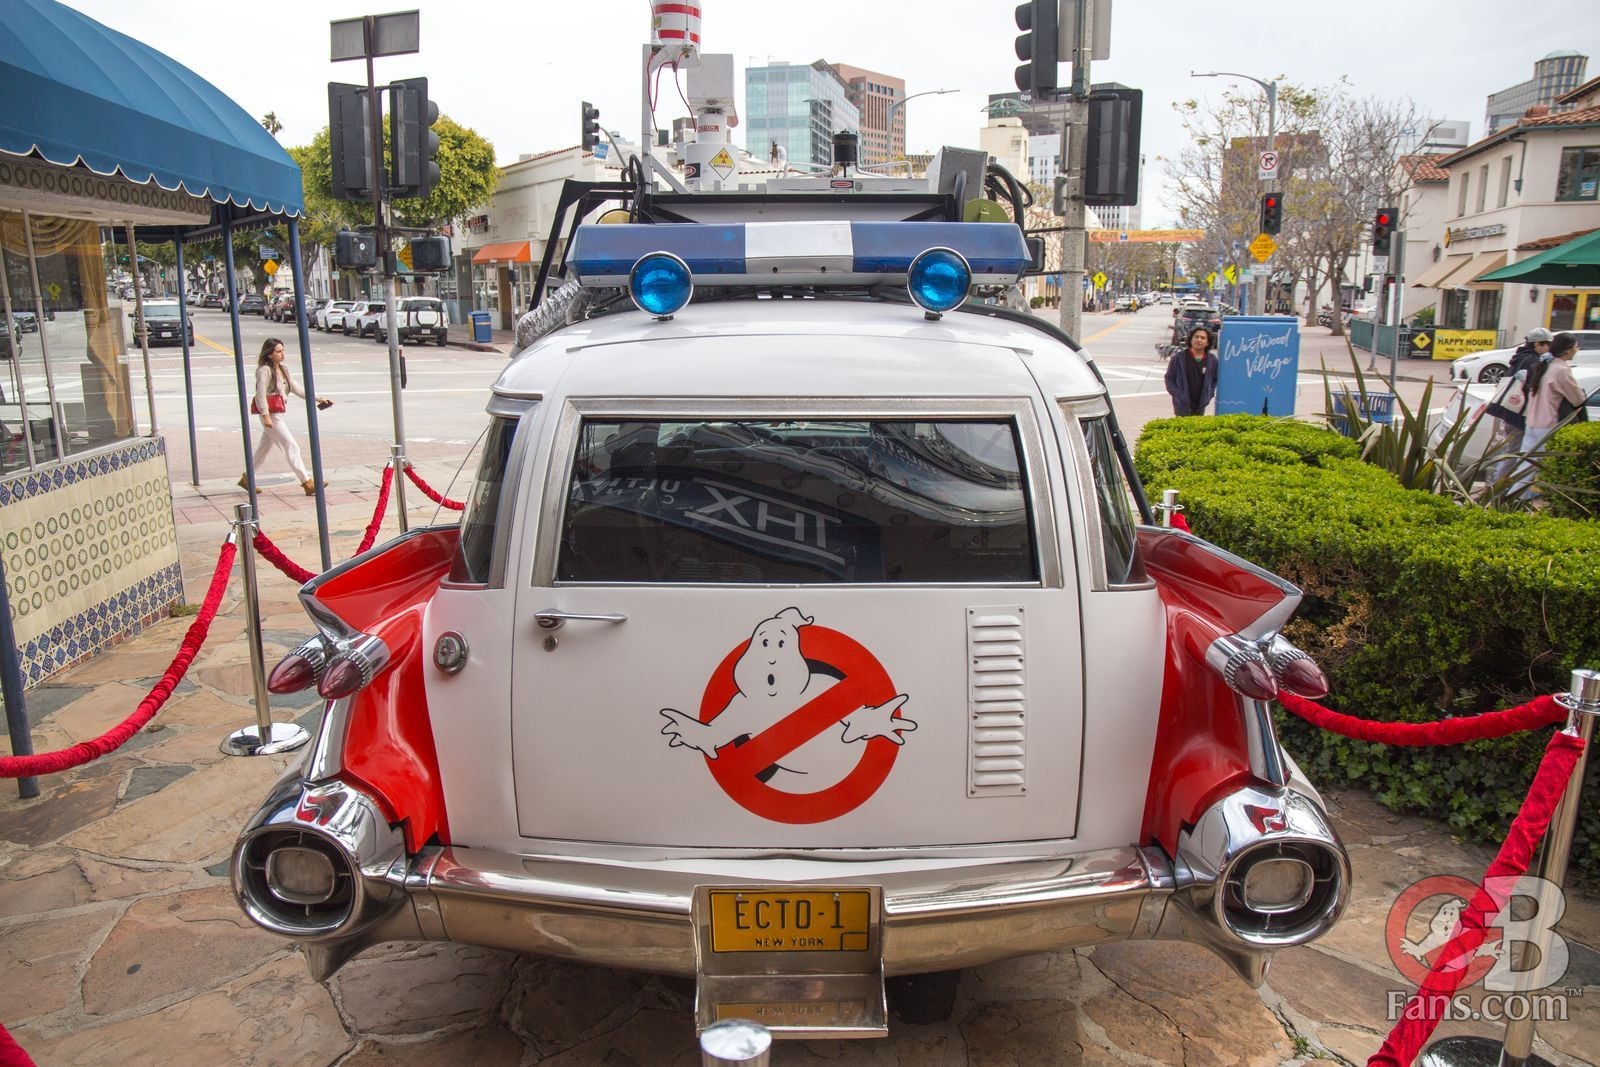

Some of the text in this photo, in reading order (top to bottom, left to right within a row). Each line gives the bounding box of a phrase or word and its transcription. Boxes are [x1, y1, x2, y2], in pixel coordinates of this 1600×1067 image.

[1224, 328, 1292, 361] Westwood
[1438, 338, 1494, 346] HAPPY HOURS
[1246, 353, 1293, 380] Village
[736, 899, 844, 930] ECTO-1
[755, 937, 824, 947] NEW YORK
